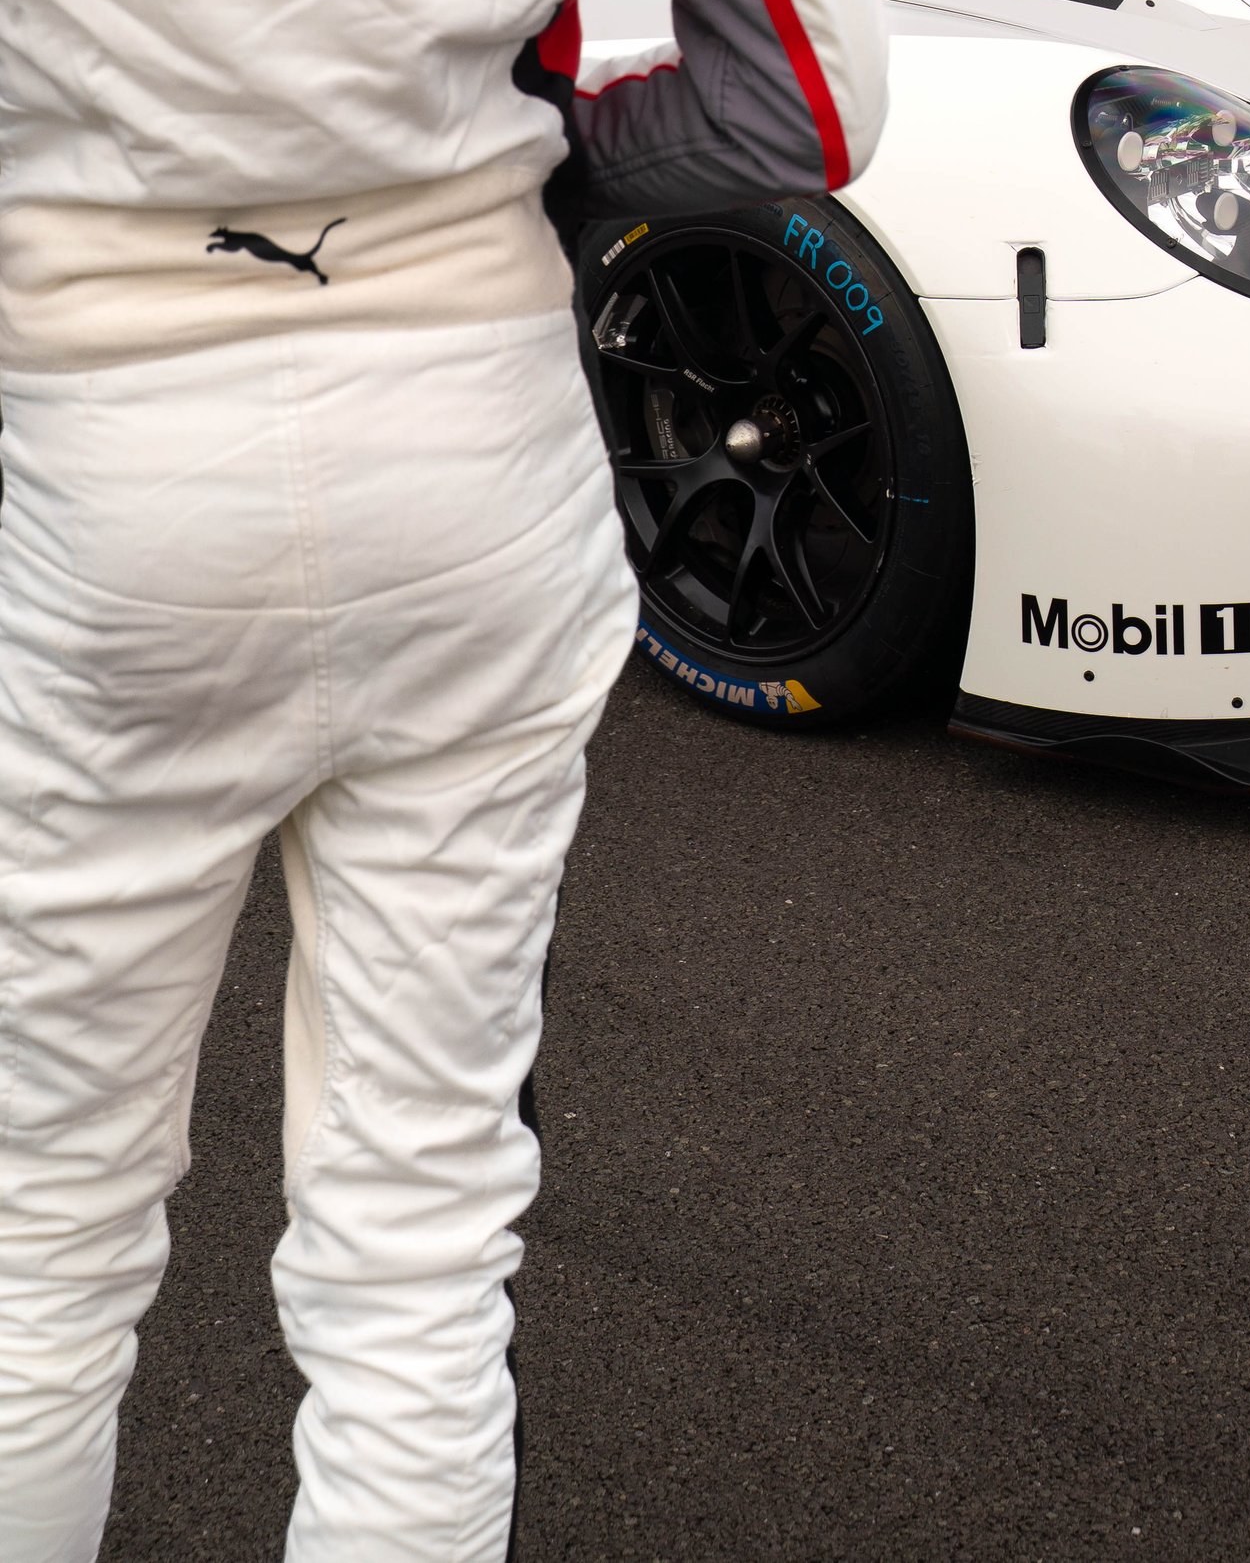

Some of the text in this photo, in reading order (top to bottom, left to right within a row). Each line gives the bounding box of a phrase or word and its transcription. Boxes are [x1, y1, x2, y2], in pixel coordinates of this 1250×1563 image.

[783, 213, 884, 336] FR 009
[683, 368, 697, 382] RSR
[1021, 593, 1185, 655] Mobil
[634, 627, 755, 707] MICHELI
